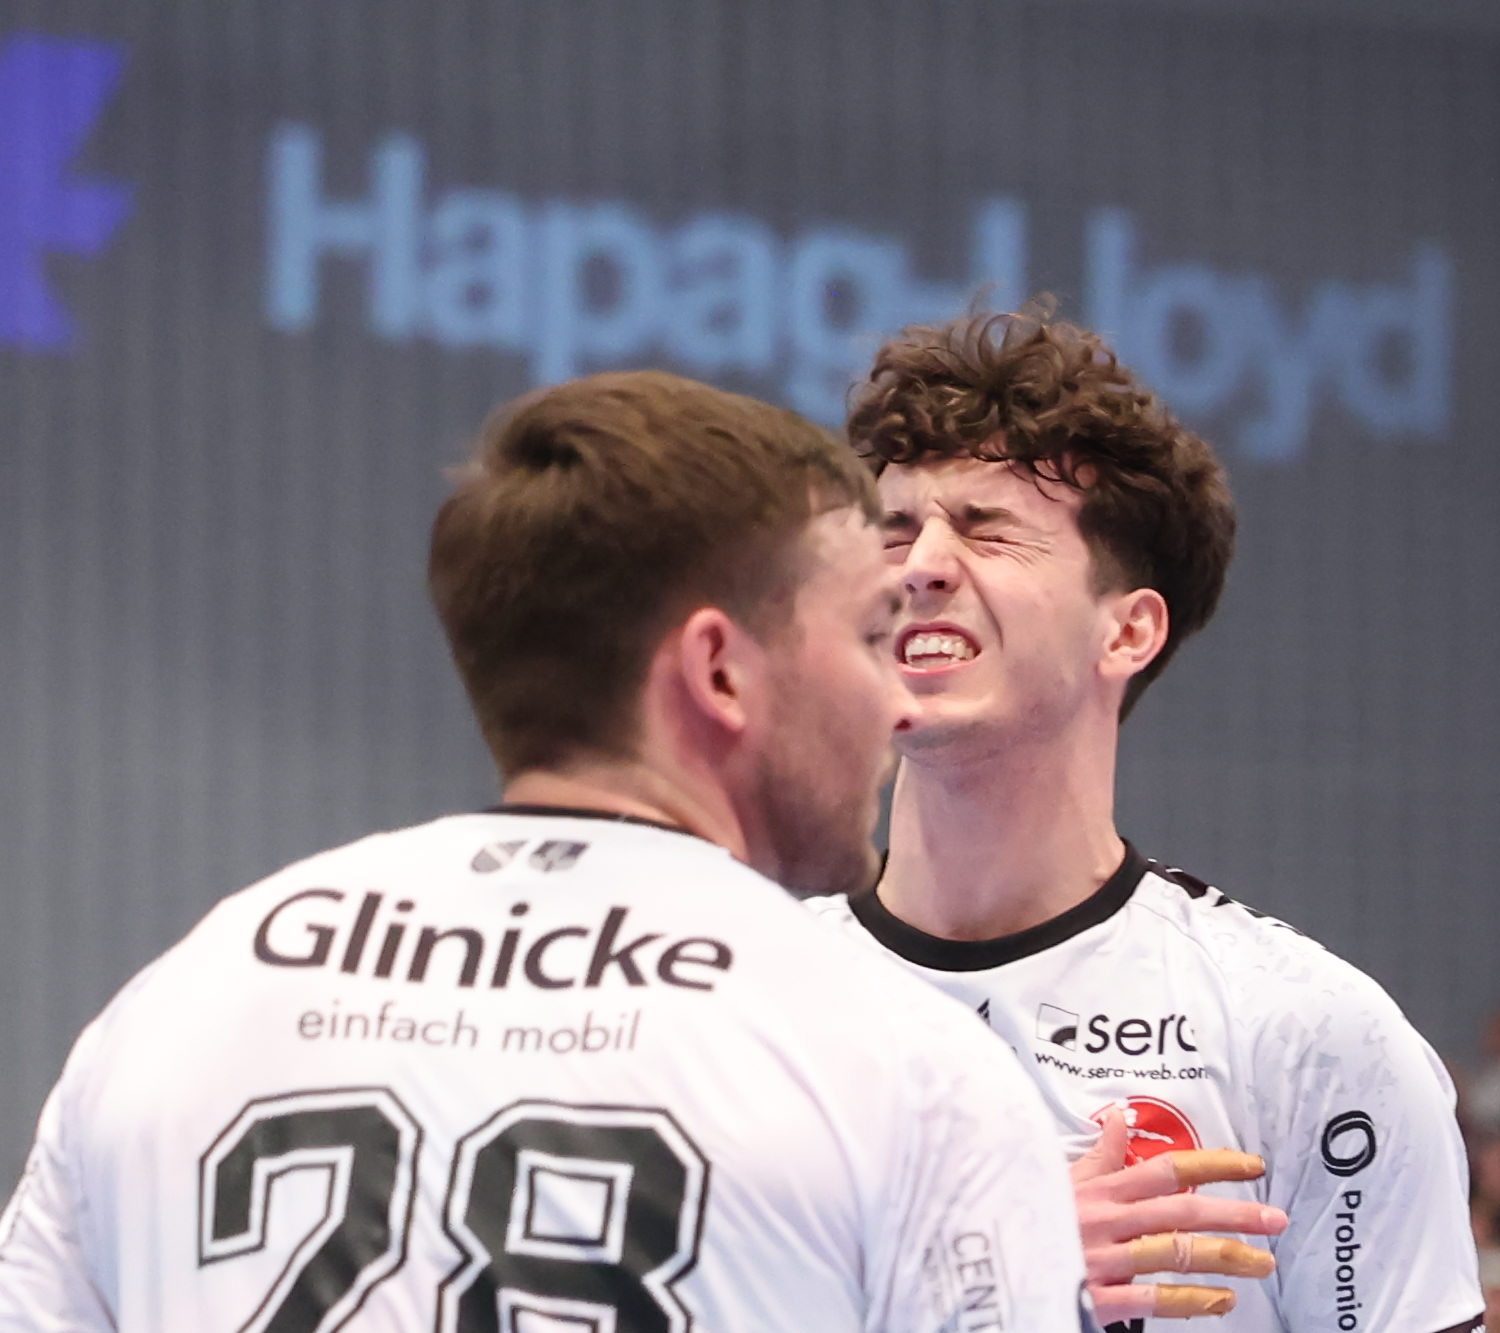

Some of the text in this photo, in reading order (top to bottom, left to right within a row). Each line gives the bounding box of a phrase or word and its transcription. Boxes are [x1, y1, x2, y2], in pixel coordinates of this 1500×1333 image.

[252, 888, 734, 991] Glinicke
[297, 999, 642, 1053] einfach mobil
[1335, 1190, 1362, 1331] Probonio
